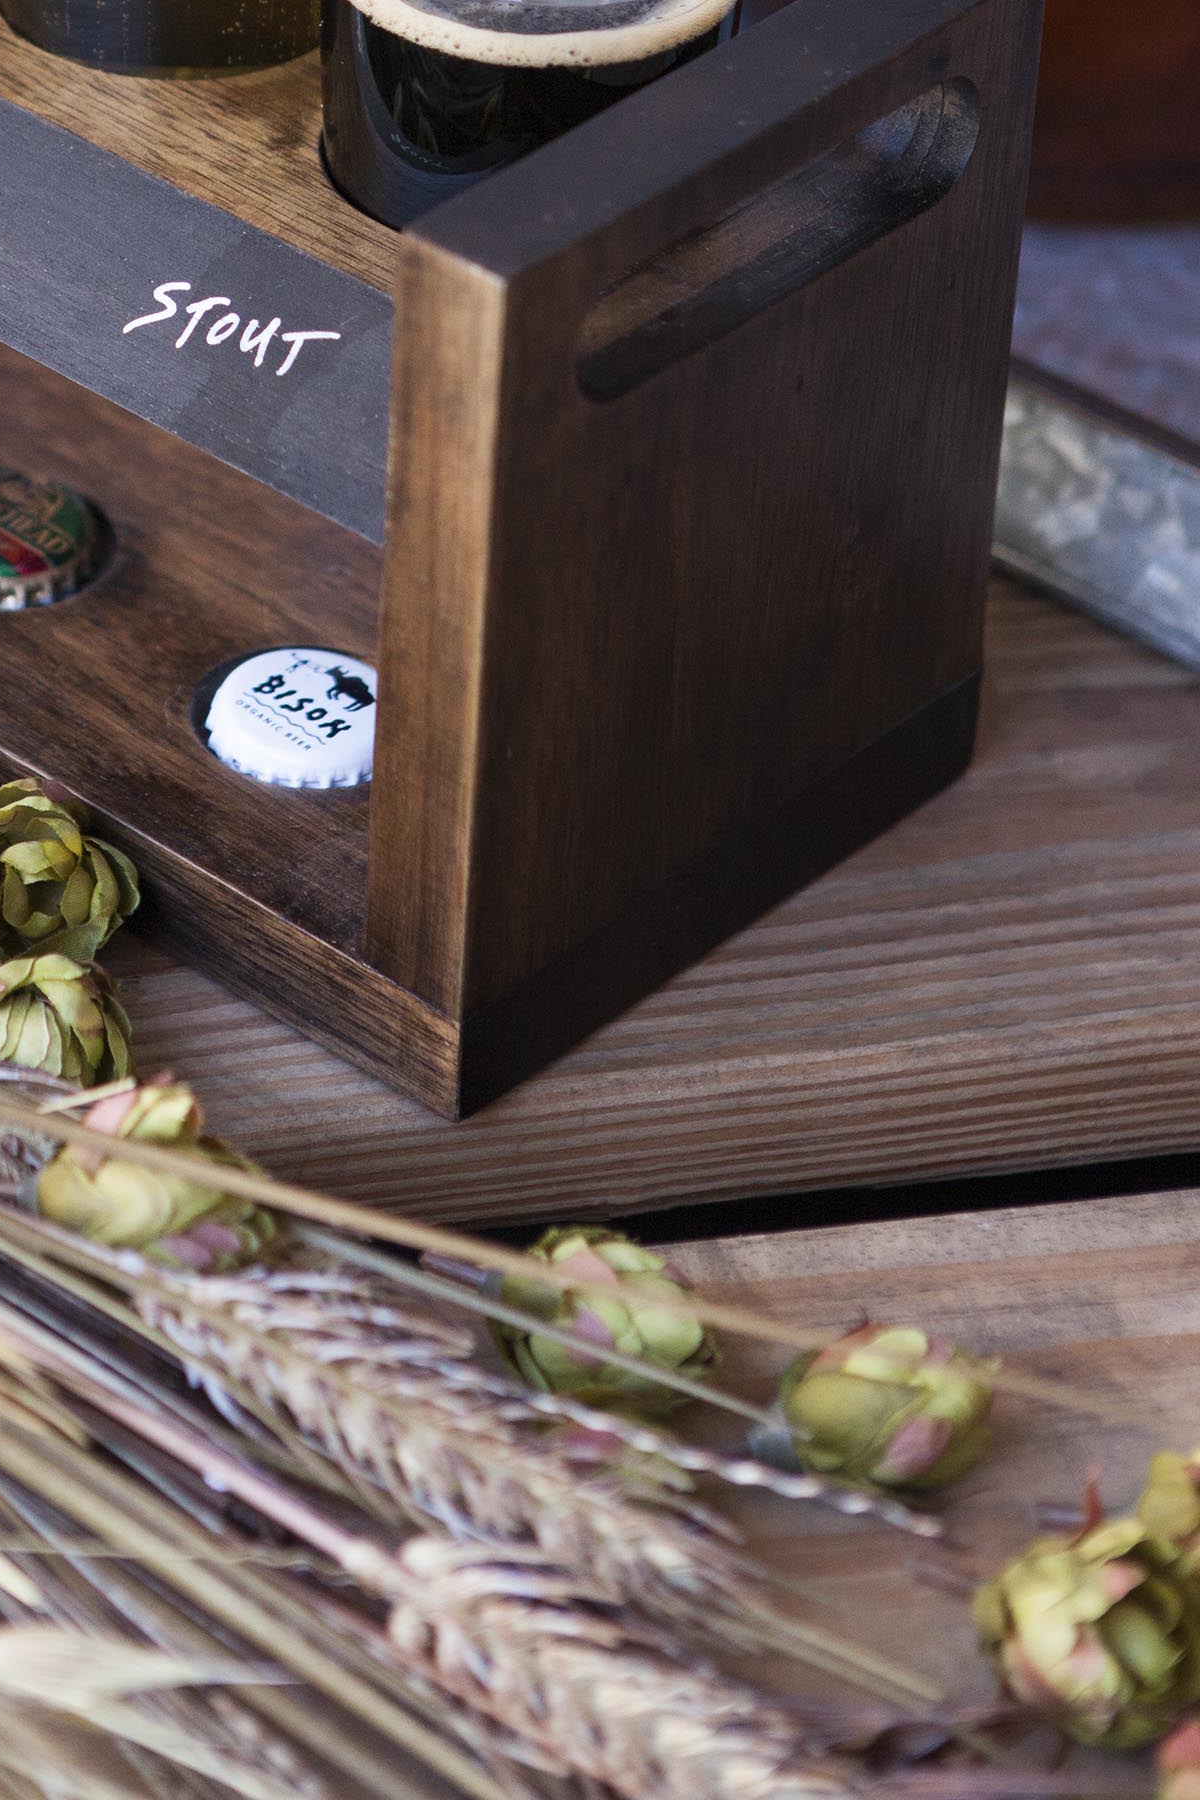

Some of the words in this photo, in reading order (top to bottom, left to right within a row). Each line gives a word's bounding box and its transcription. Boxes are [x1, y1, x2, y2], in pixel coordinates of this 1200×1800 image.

[122, 281, 341, 376] STOUT
[235, 699, 283, 732] ORGANIC
[284, 732, 312, 751] BEER
[252, 674, 352, 738] BISON
